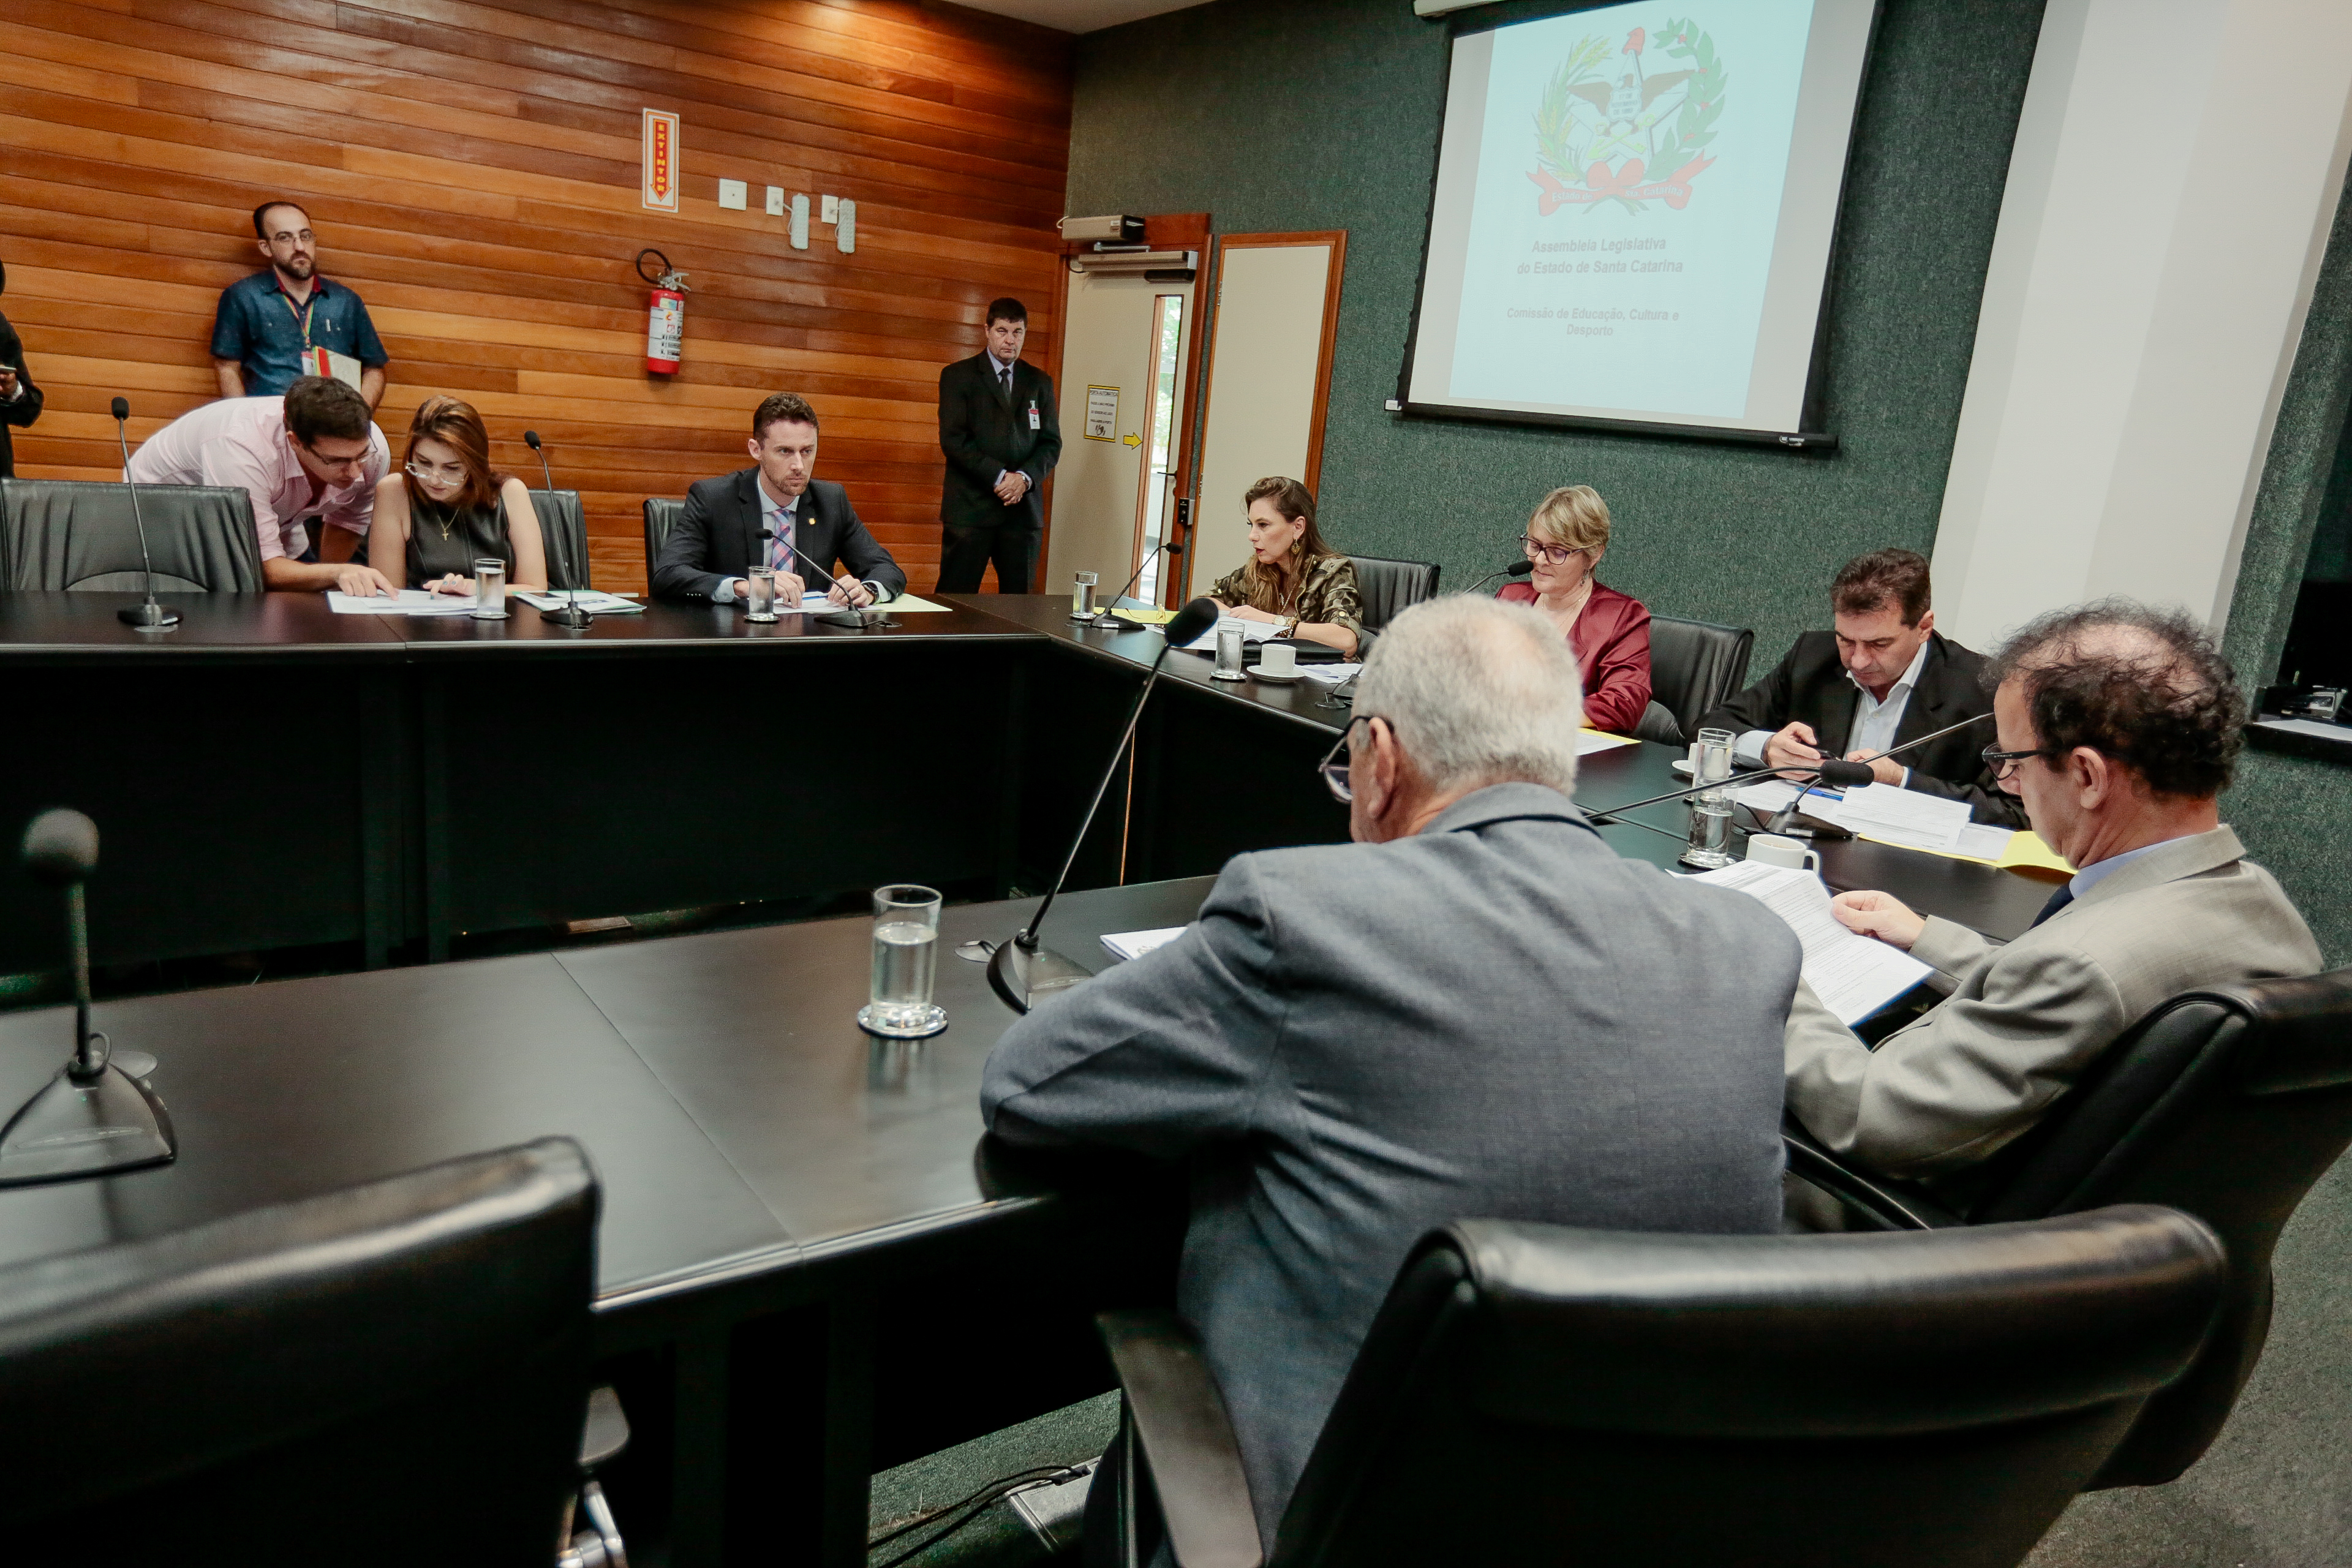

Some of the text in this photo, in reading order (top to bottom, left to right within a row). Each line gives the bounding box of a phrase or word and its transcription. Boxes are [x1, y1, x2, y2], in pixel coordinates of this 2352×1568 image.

[656, 124, 666, 192] EXTINTOR
[1552, 192, 1581, 202] Estado
[1532, 237, 1666, 254] Assembleia Legislativa
[1517, 259, 1683, 274] do Estado de Santa Catarina
[1507, 306, 1679, 322] Comissão de Educação, Cultura e
[1567, 323, 1613, 337] Desporto
